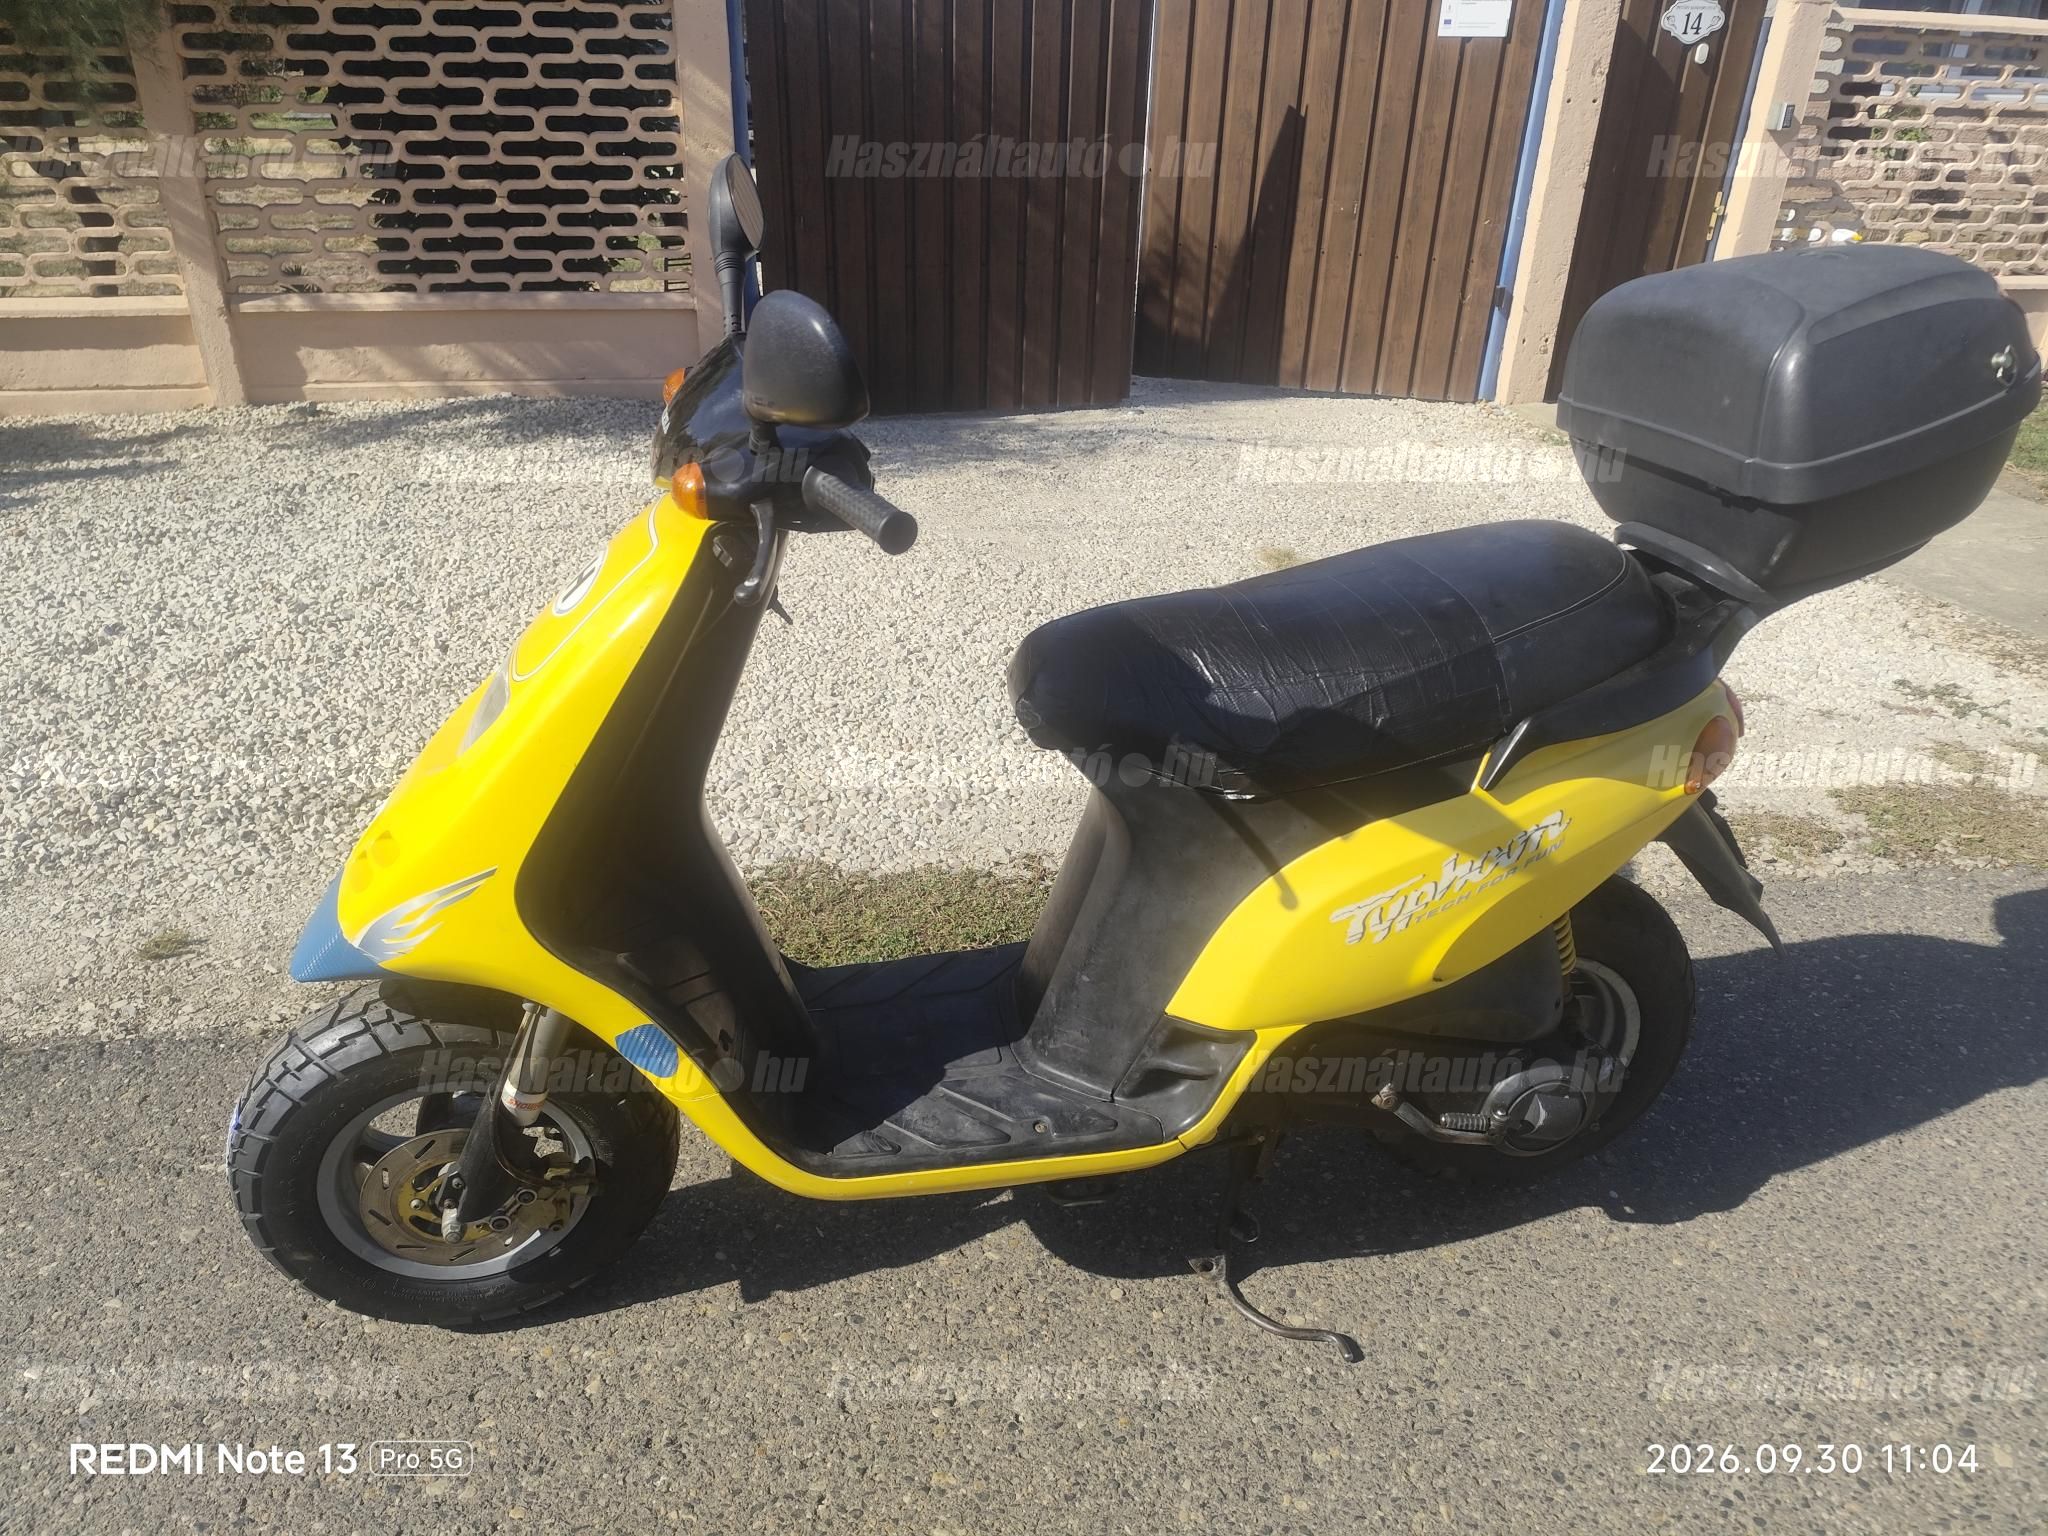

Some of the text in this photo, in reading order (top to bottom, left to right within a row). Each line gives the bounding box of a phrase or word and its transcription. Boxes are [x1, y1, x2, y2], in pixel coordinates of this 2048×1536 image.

[1682, 12, 1703, 35] 14
[1414, 838, 1566, 923] TECH FOR FUN
